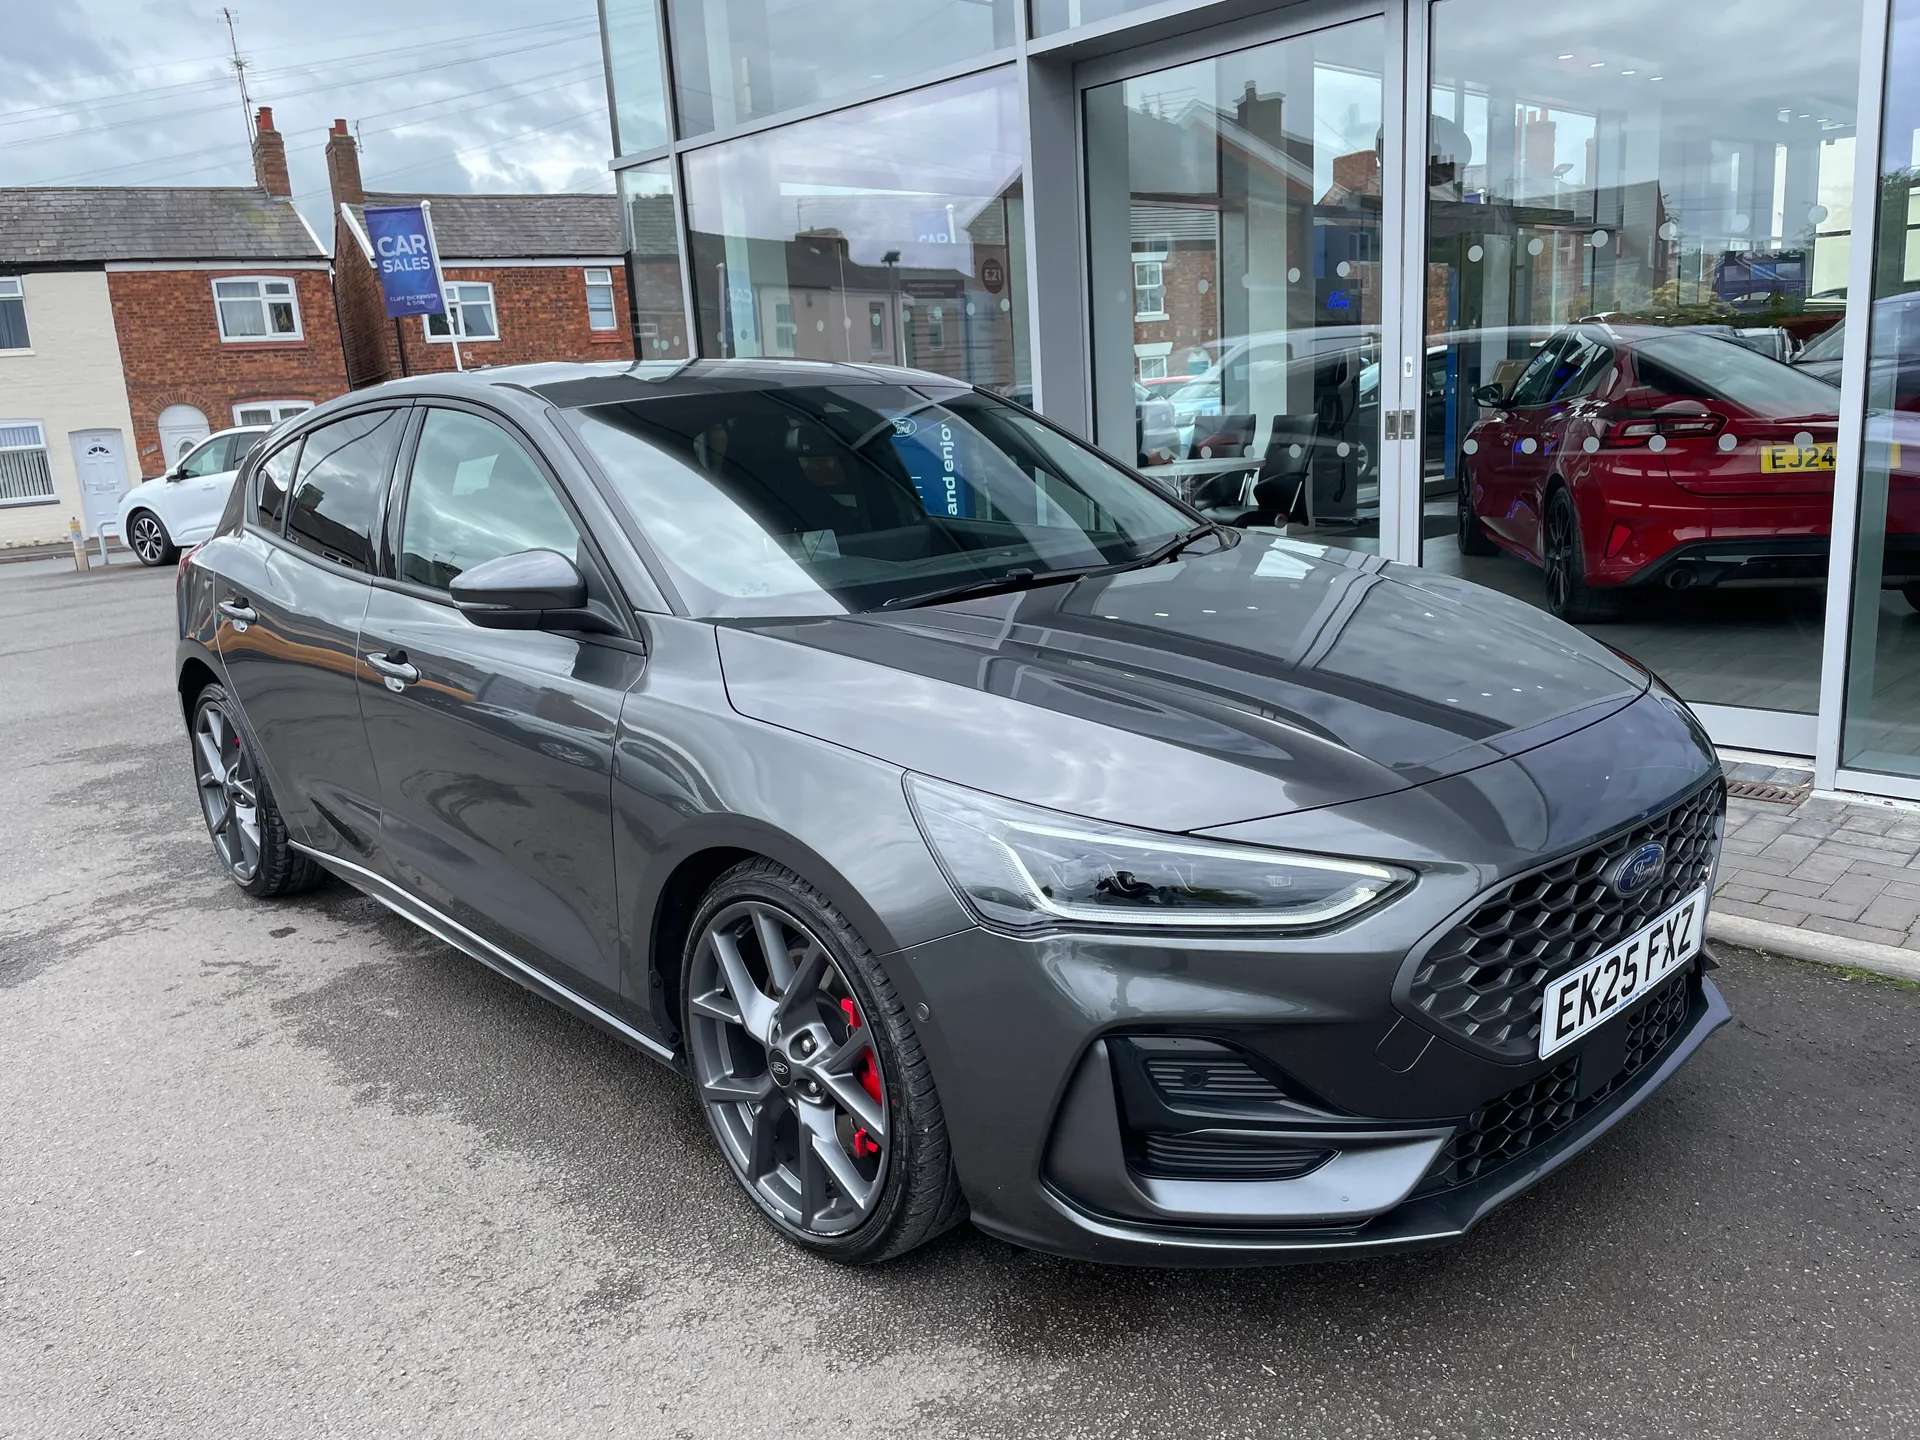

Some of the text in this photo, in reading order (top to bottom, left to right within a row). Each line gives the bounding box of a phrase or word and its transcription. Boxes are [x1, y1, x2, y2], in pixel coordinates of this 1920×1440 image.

[377, 234, 427, 256] CAR
[382, 257, 430, 273] SALES
[1772, 447, 1836, 469] EJ24
[940, 424, 957, 515] and enjo
[1556, 901, 1696, 1041] EK25 FXZ
